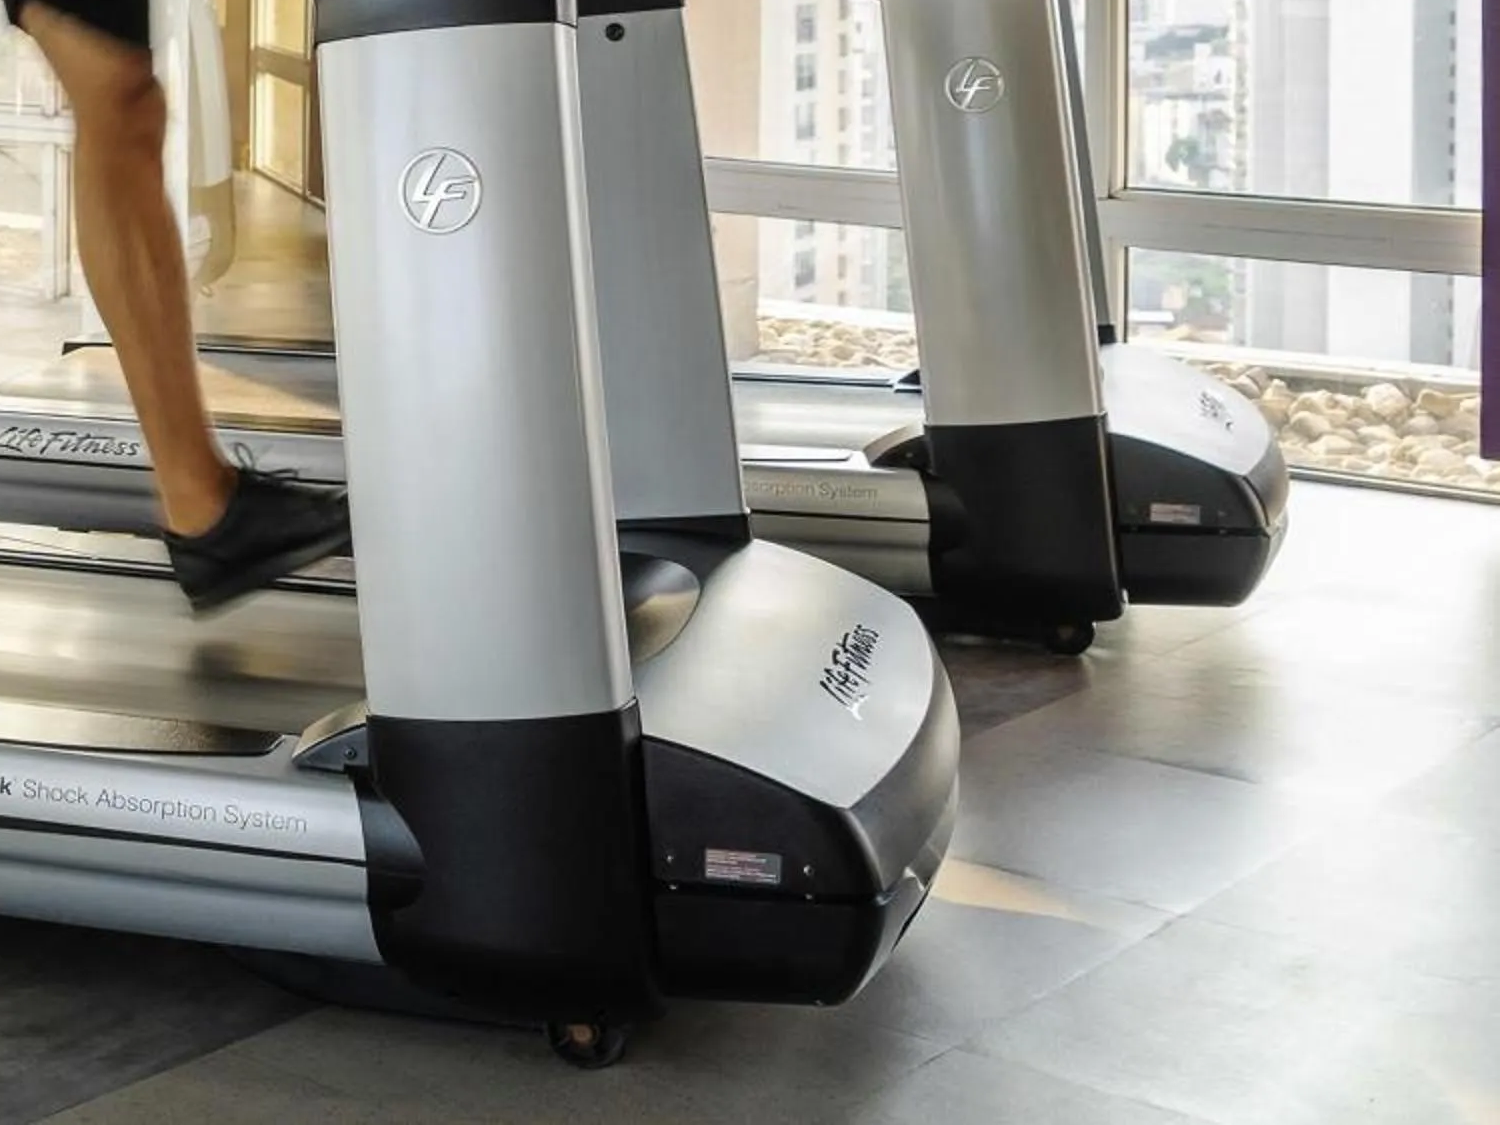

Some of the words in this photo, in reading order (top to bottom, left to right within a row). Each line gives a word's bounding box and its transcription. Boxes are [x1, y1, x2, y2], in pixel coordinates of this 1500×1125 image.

[22, 778, 89, 806] Shock
[95, 788, 217, 820] Absorption
[223, 804, 308, 833] System
